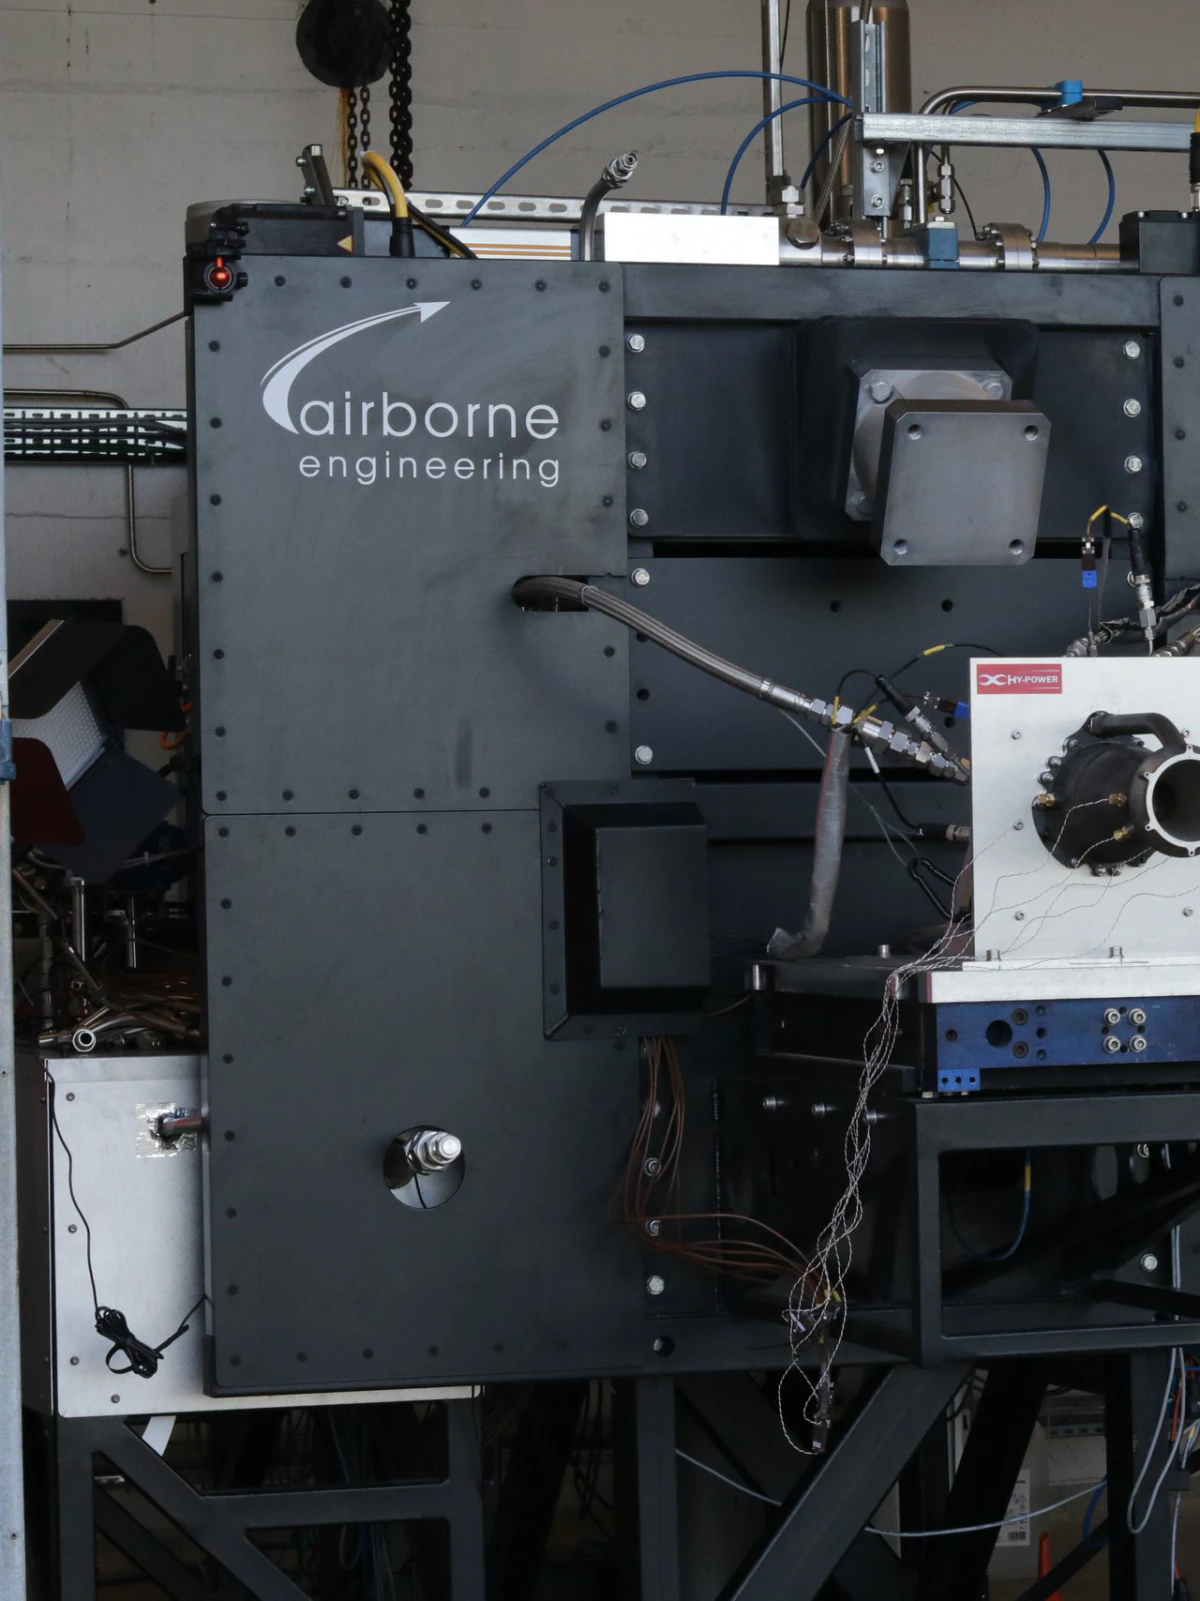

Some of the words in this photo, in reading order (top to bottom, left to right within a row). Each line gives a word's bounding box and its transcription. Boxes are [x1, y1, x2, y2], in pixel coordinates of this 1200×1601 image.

[300, 391, 559, 439] airborne
[299, 451, 559, 487] engineering
[1007, 674, 1058, 685] HY-POWER
